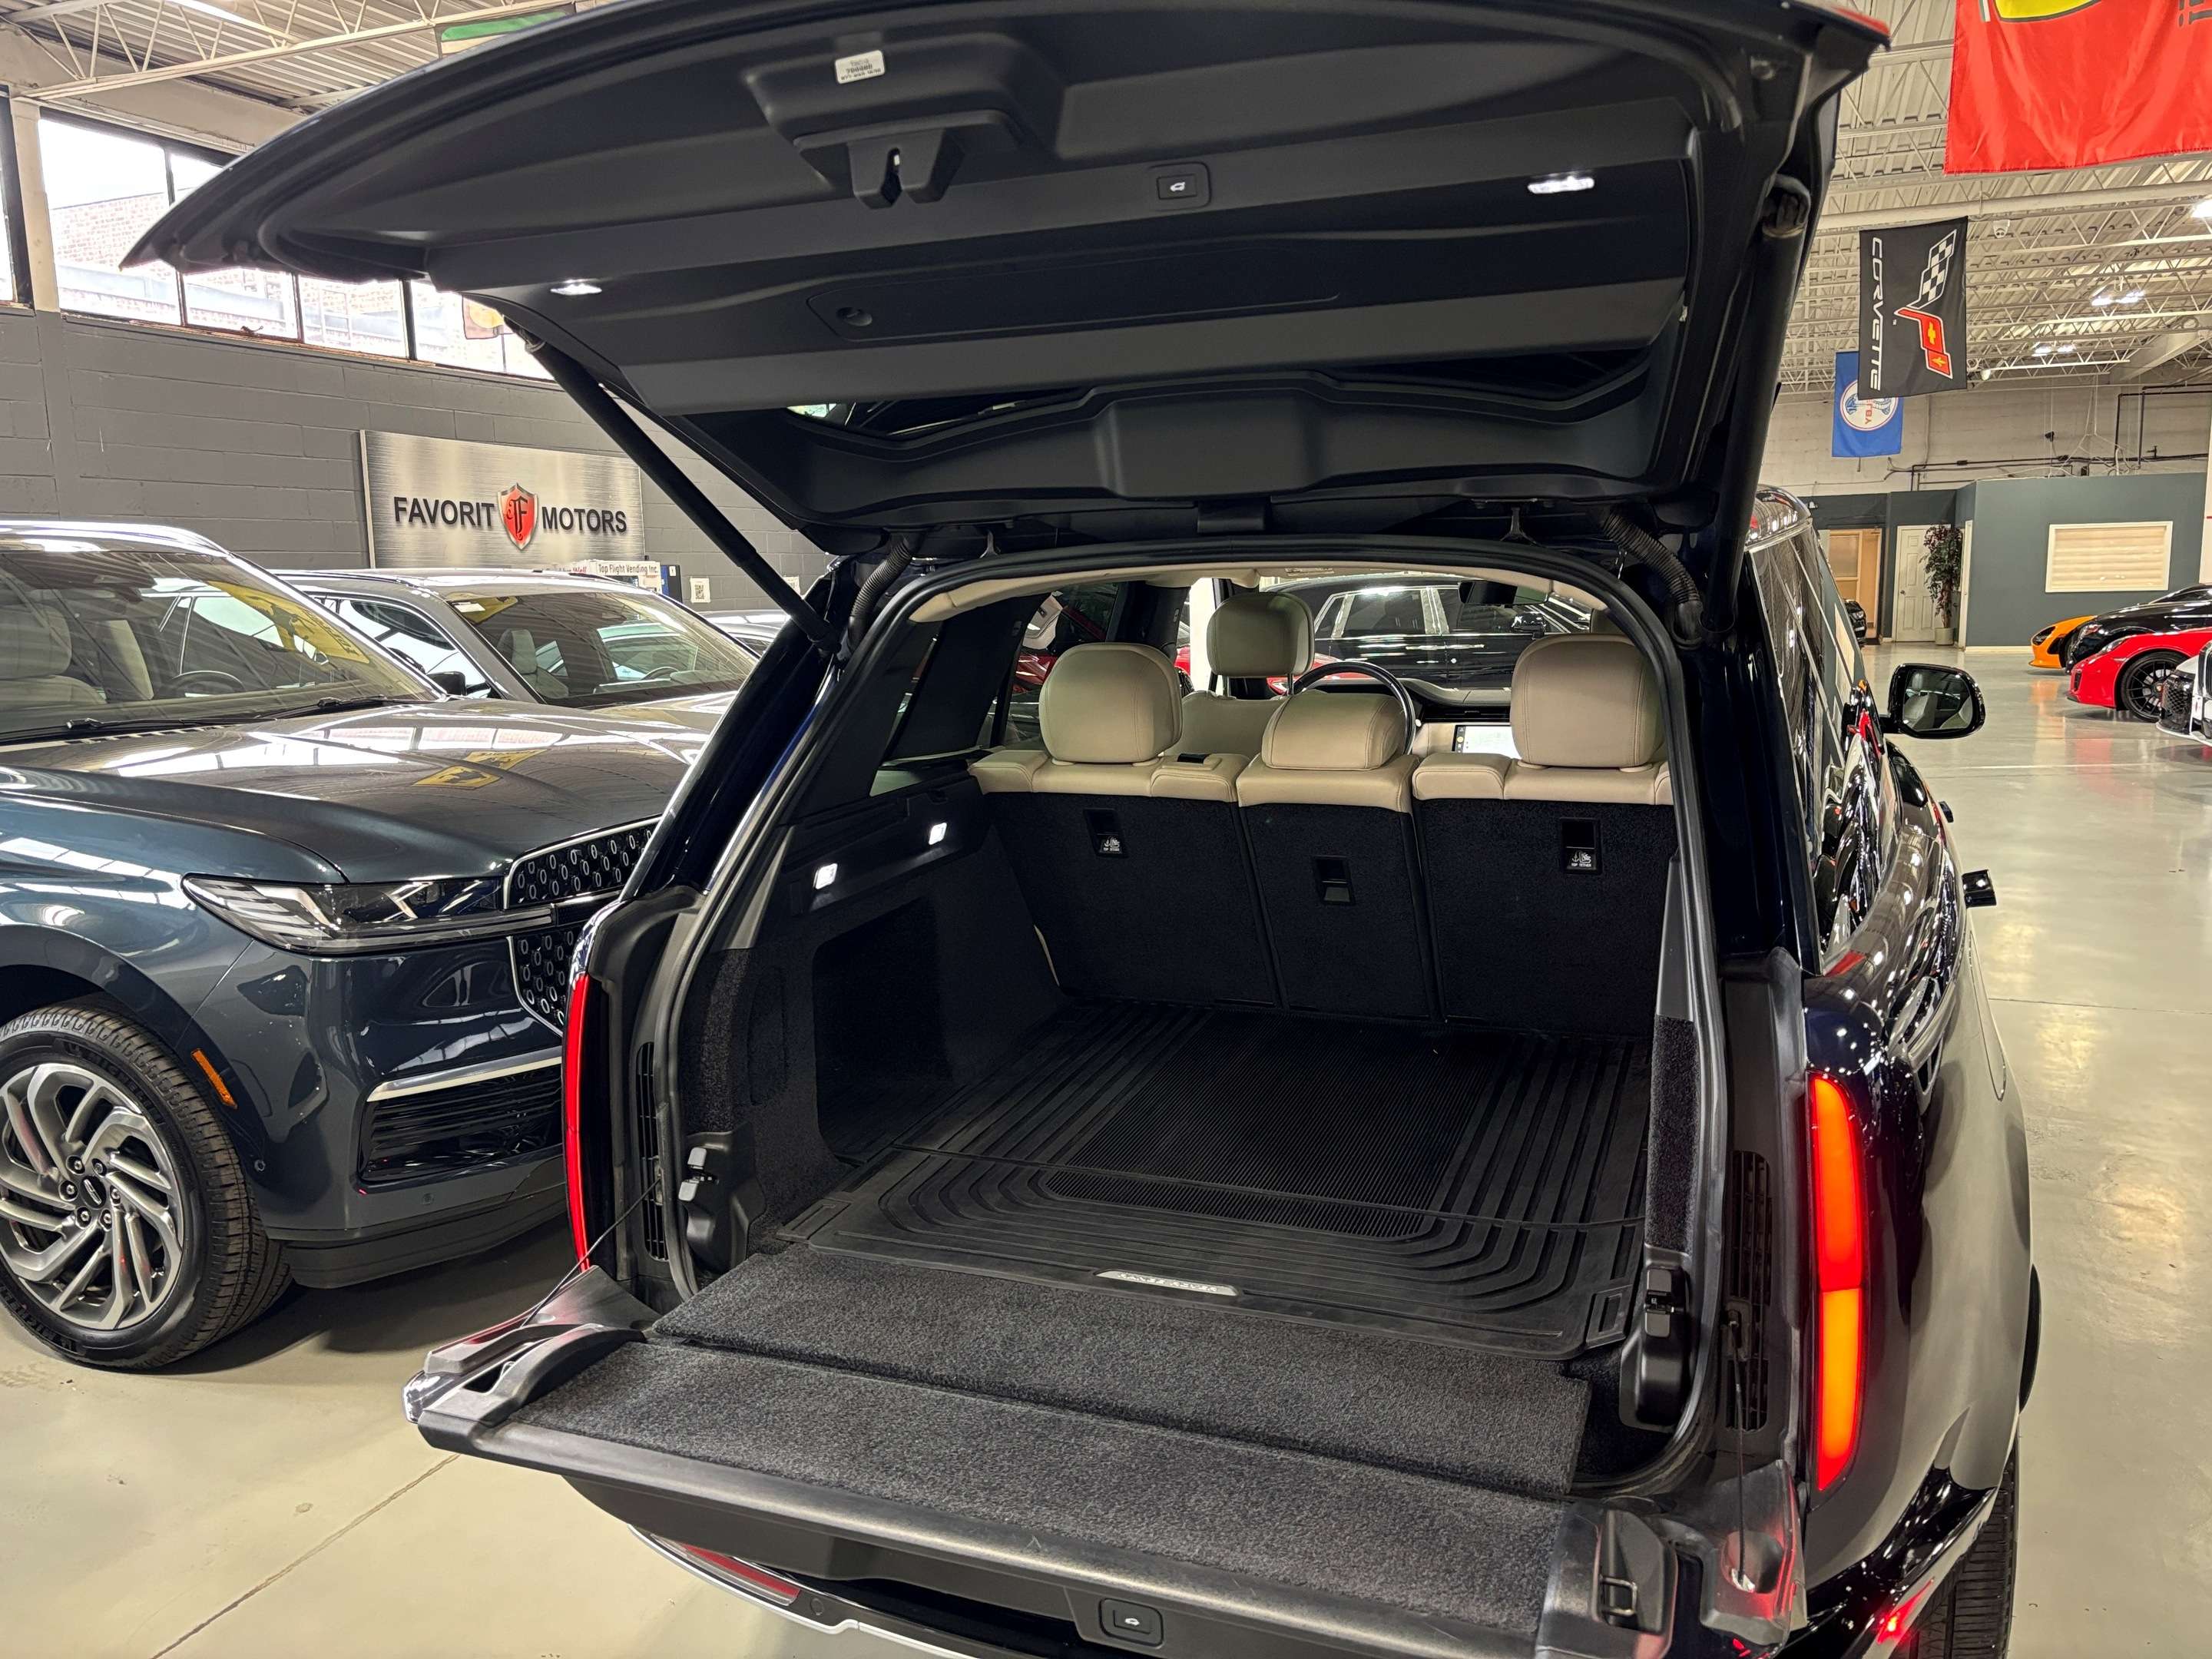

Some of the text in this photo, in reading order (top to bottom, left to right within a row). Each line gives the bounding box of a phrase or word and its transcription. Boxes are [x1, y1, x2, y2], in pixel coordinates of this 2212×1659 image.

[1870, 237, 1883, 391] CORVETTE
[393, 496, 628, 533] FAVORIT MOTORS
[598, 564, 608, 575] Top
[609, 564, 625, 575] Flight
[626, 565, 647, 576] Vending
